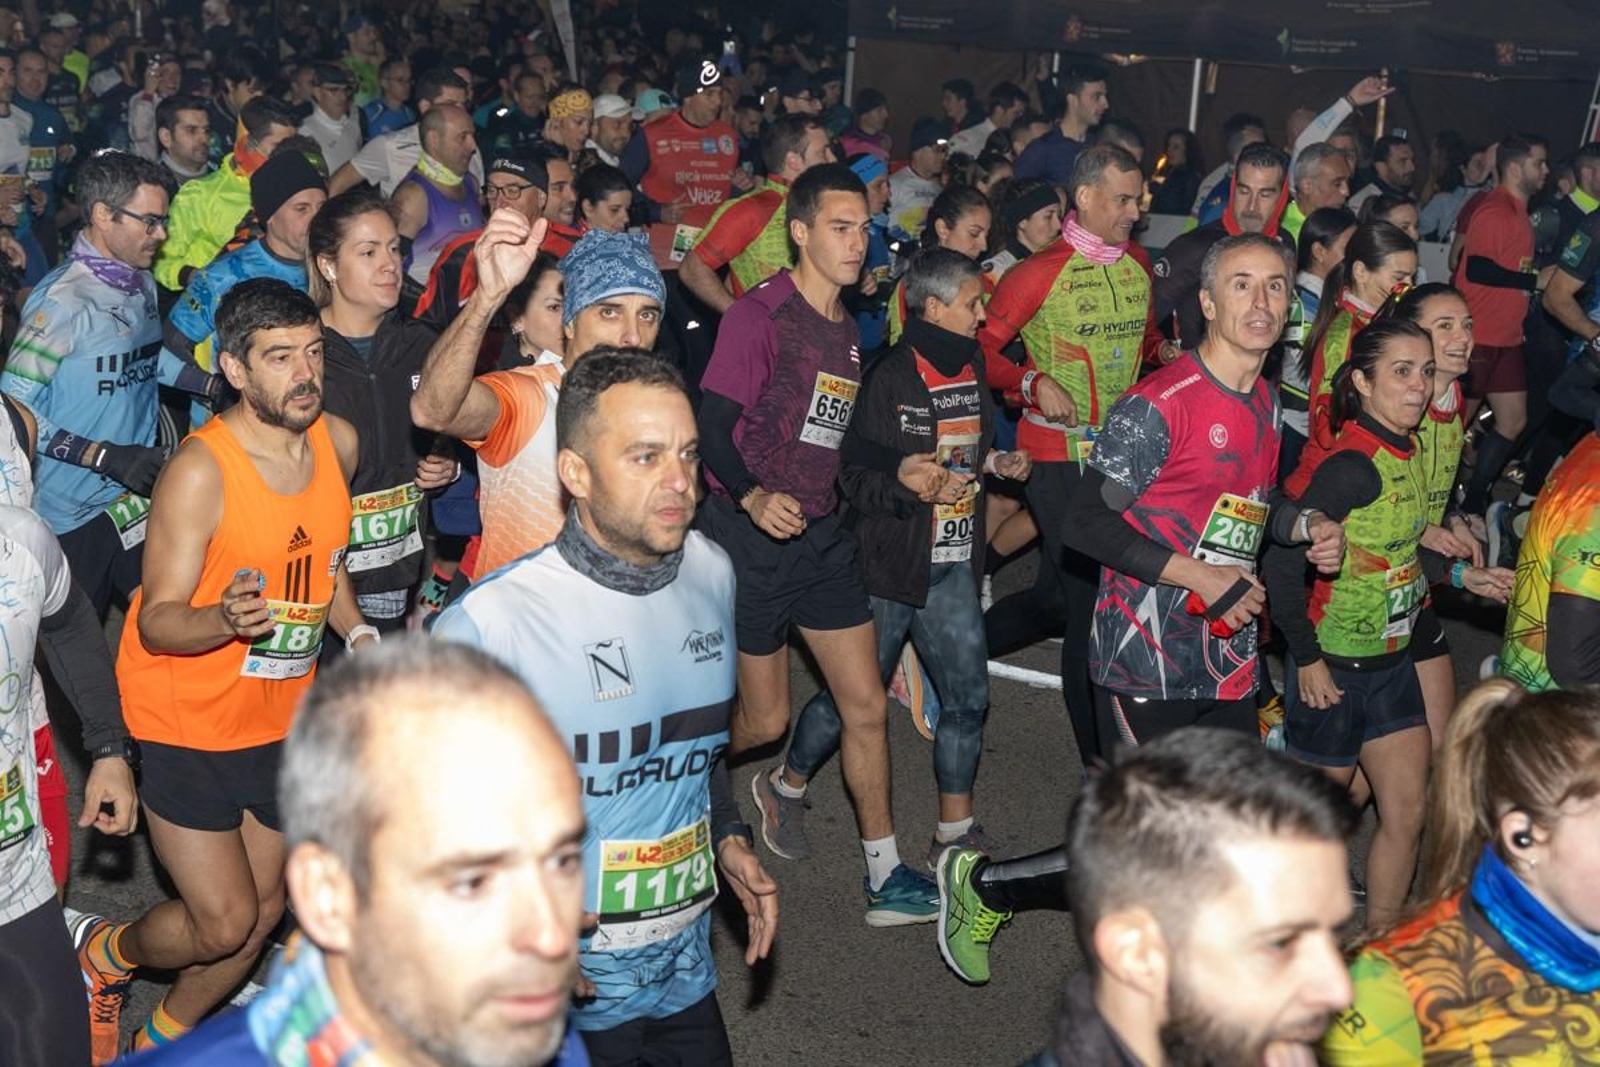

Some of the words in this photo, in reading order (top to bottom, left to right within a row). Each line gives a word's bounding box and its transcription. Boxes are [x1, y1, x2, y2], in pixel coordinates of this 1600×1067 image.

[359, 496, 377, 511] 42
[287, 539, 312, 553] adidas
[287, 607, 309, 621] 42
[590, 639, 633, 692] Ñ
[636, 846, 662, 864] 42
[614, 851, 708, 911] 1179
